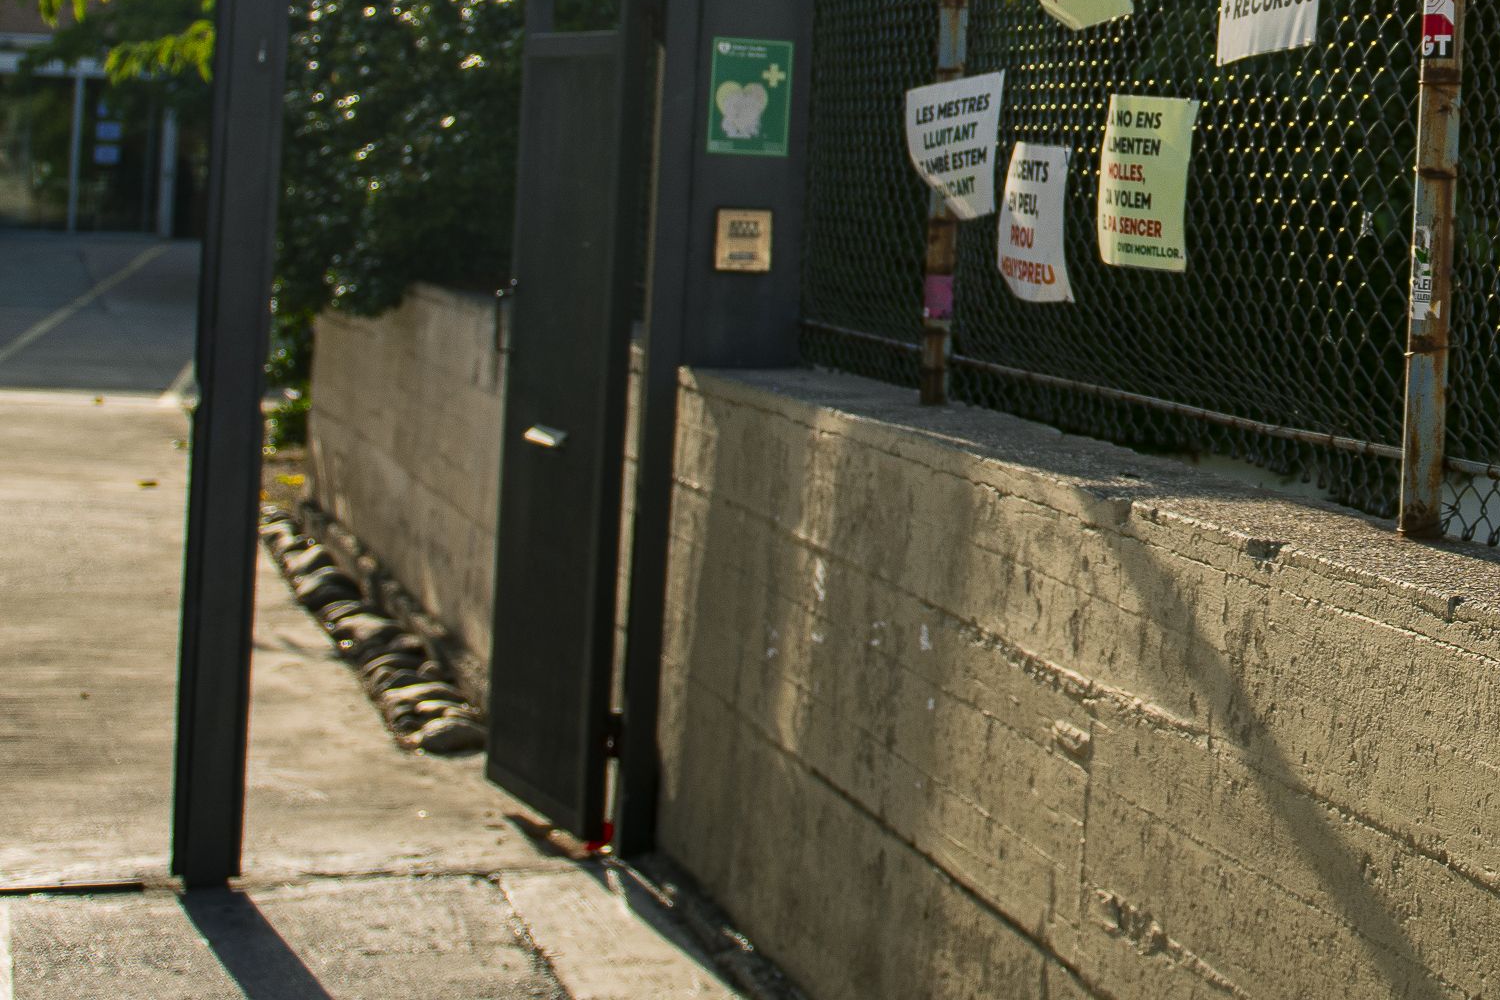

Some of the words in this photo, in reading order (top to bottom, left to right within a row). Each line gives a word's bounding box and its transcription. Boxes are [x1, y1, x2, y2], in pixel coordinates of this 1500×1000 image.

[916, 104, 934, 125] LES
[937, 93, 991, 120] MESTRES
[1116, 110, 1132, 128] NO
[1136, 111, 1163, 129] ENS
[924, 122, 978, 150] LLUITANT
[952, 146, 988, 169] ESTEM
[1114, 190, 1151, 210] VOLEM
[1010, 224, 1034, 249] PROU
[1119, 217, 1162, 238] SENCER
